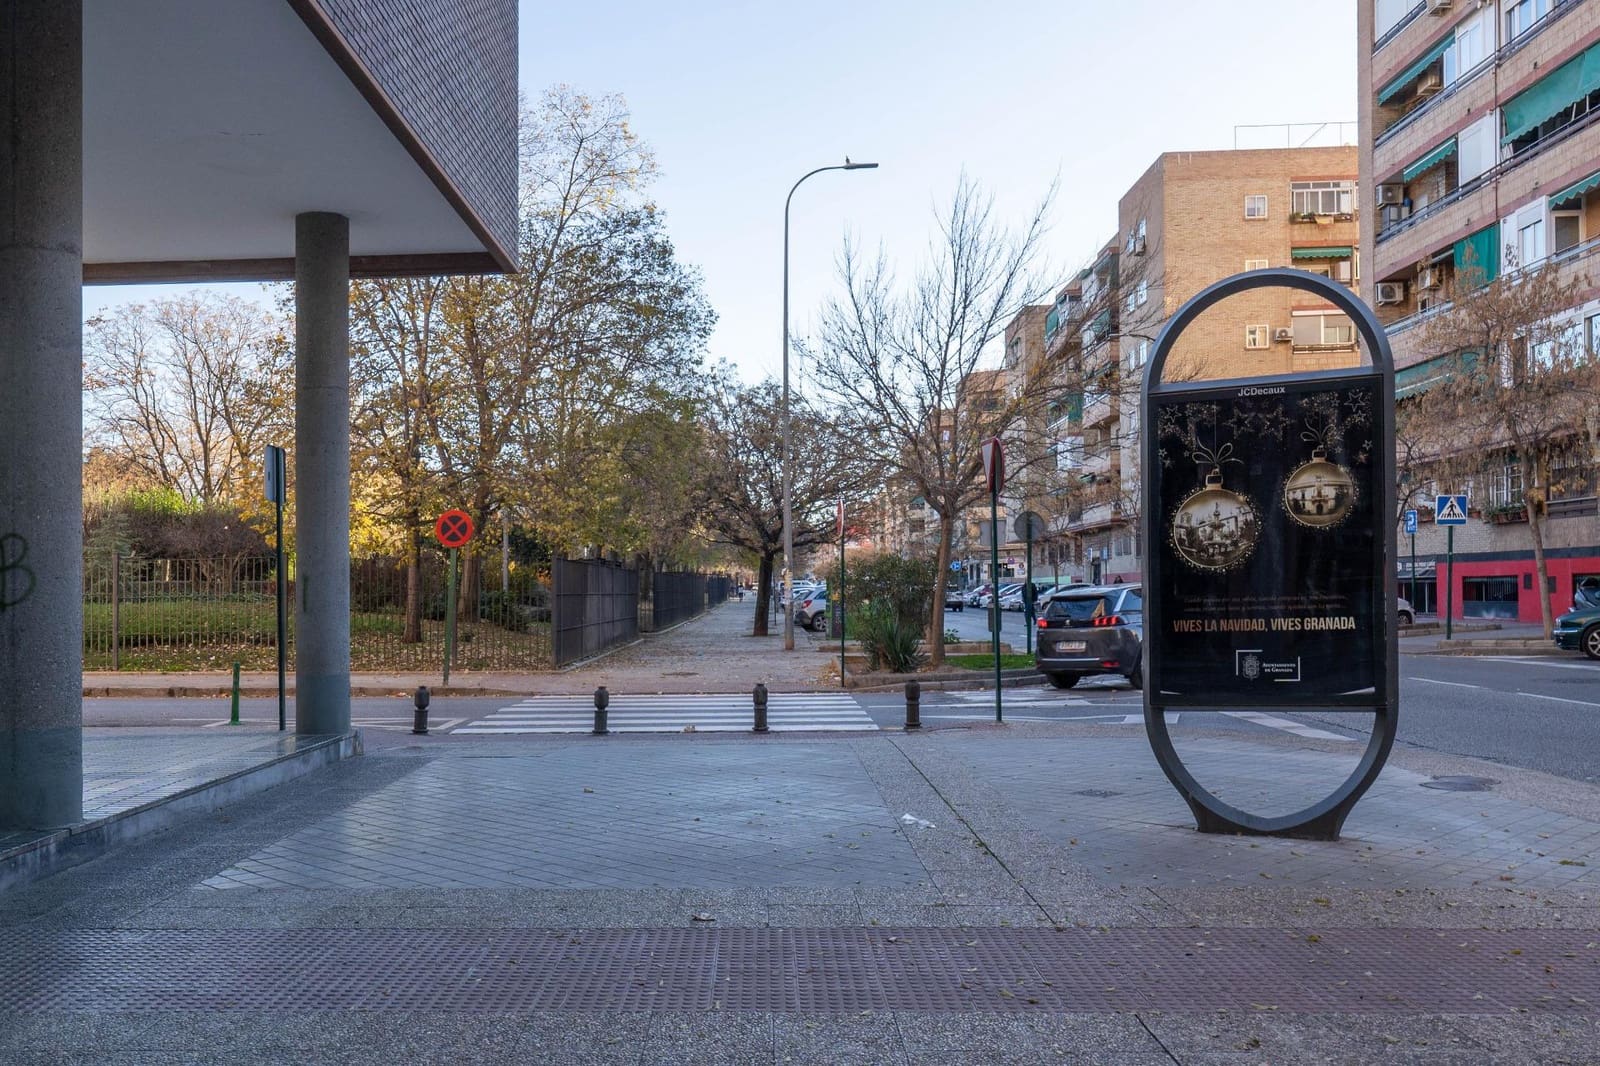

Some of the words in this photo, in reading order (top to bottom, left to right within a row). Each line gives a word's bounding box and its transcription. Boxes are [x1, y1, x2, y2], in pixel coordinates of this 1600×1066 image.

[1238, 386, 1285, 396] JCDecaux
[1173, 619, 1202, 633] VIVES
[1204, 619, 1218, 632] LA
[1220, 618, 1268, 632] NAVIDAD,
[1270, 617, 1301, 631] VIVES
[1303, 616, 1356, 630] GRANADA
